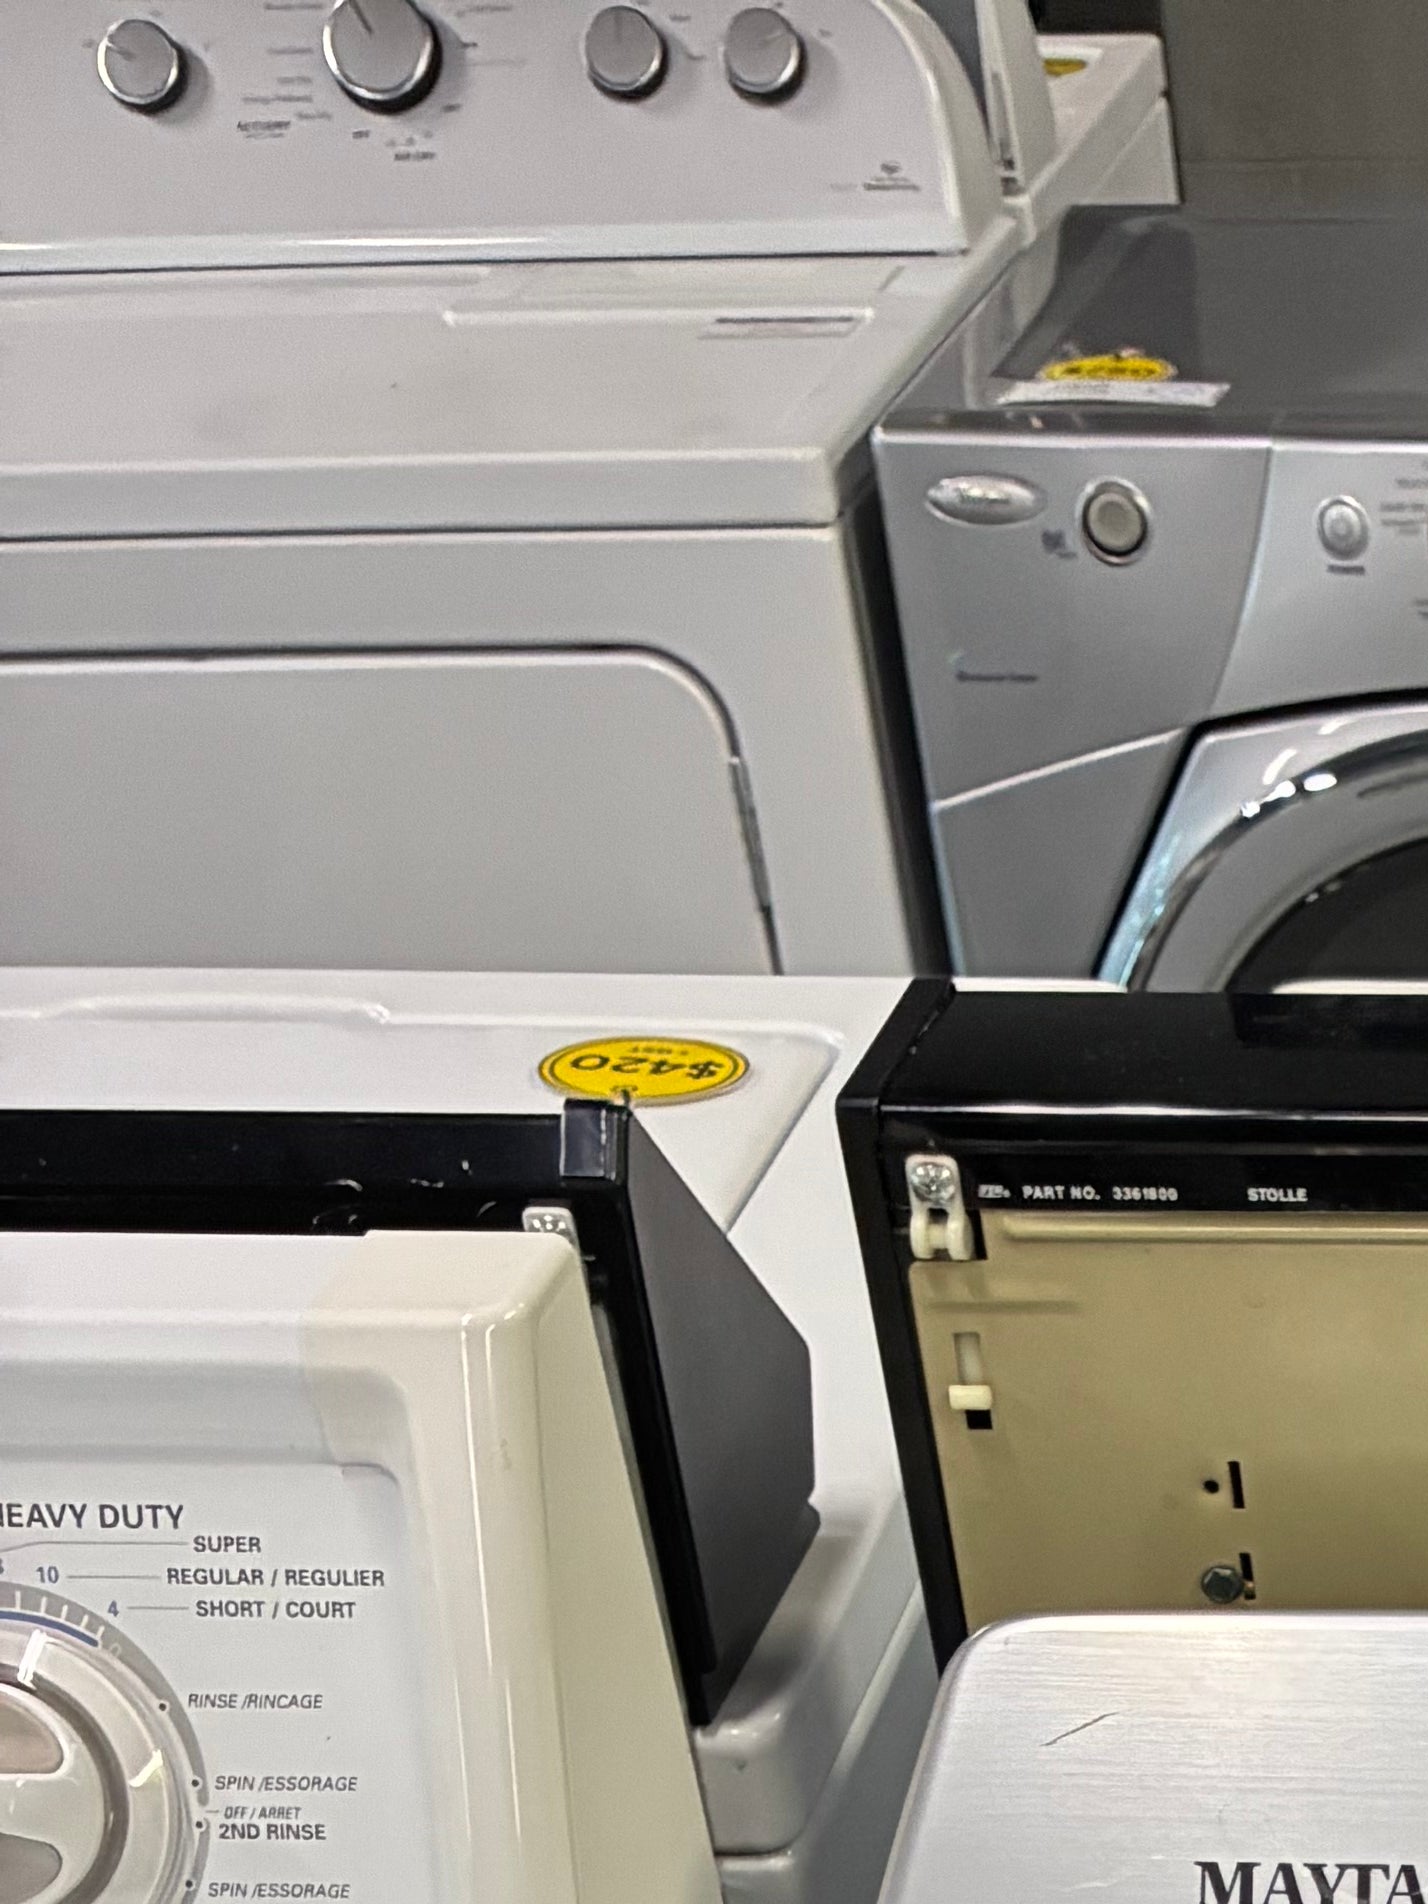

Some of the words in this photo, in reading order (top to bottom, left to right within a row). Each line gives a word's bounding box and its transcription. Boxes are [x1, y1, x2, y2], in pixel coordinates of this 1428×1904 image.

[570, 1053, 724, 1080] $420
[1022, 1185, 1065, 1200] PART
[1070, 1185, 1101, 1201] NO.
[1247, 1187, 1308, 1202] STOLLE
[99, 1503, 184, 1530] DUTY
[193, 1535, 262, 1554] SUPER
[36, 1566, 59, 1584] 10
[166, 1568, 265, 1587] REGULAR
[285, 1568, 386, 1588] REGULIER
[107, 1600, 120, 1617] 4
[195, 1601, 266, 1618] SHORT
[285, 1601, 357, 1619] COURT
[187, 1693, 237, 1710] RINSE
[214, 1775, 255, 1792] SPIN
[224, 1806, 248, 1820] OFF
[258, 1806, 302, 1820] ARRET
[218, 1823, 261, 1841] 2ND
[266, 1823, 327, 1841] RINSE
[208, 1882, 248, 1899] SPIN
